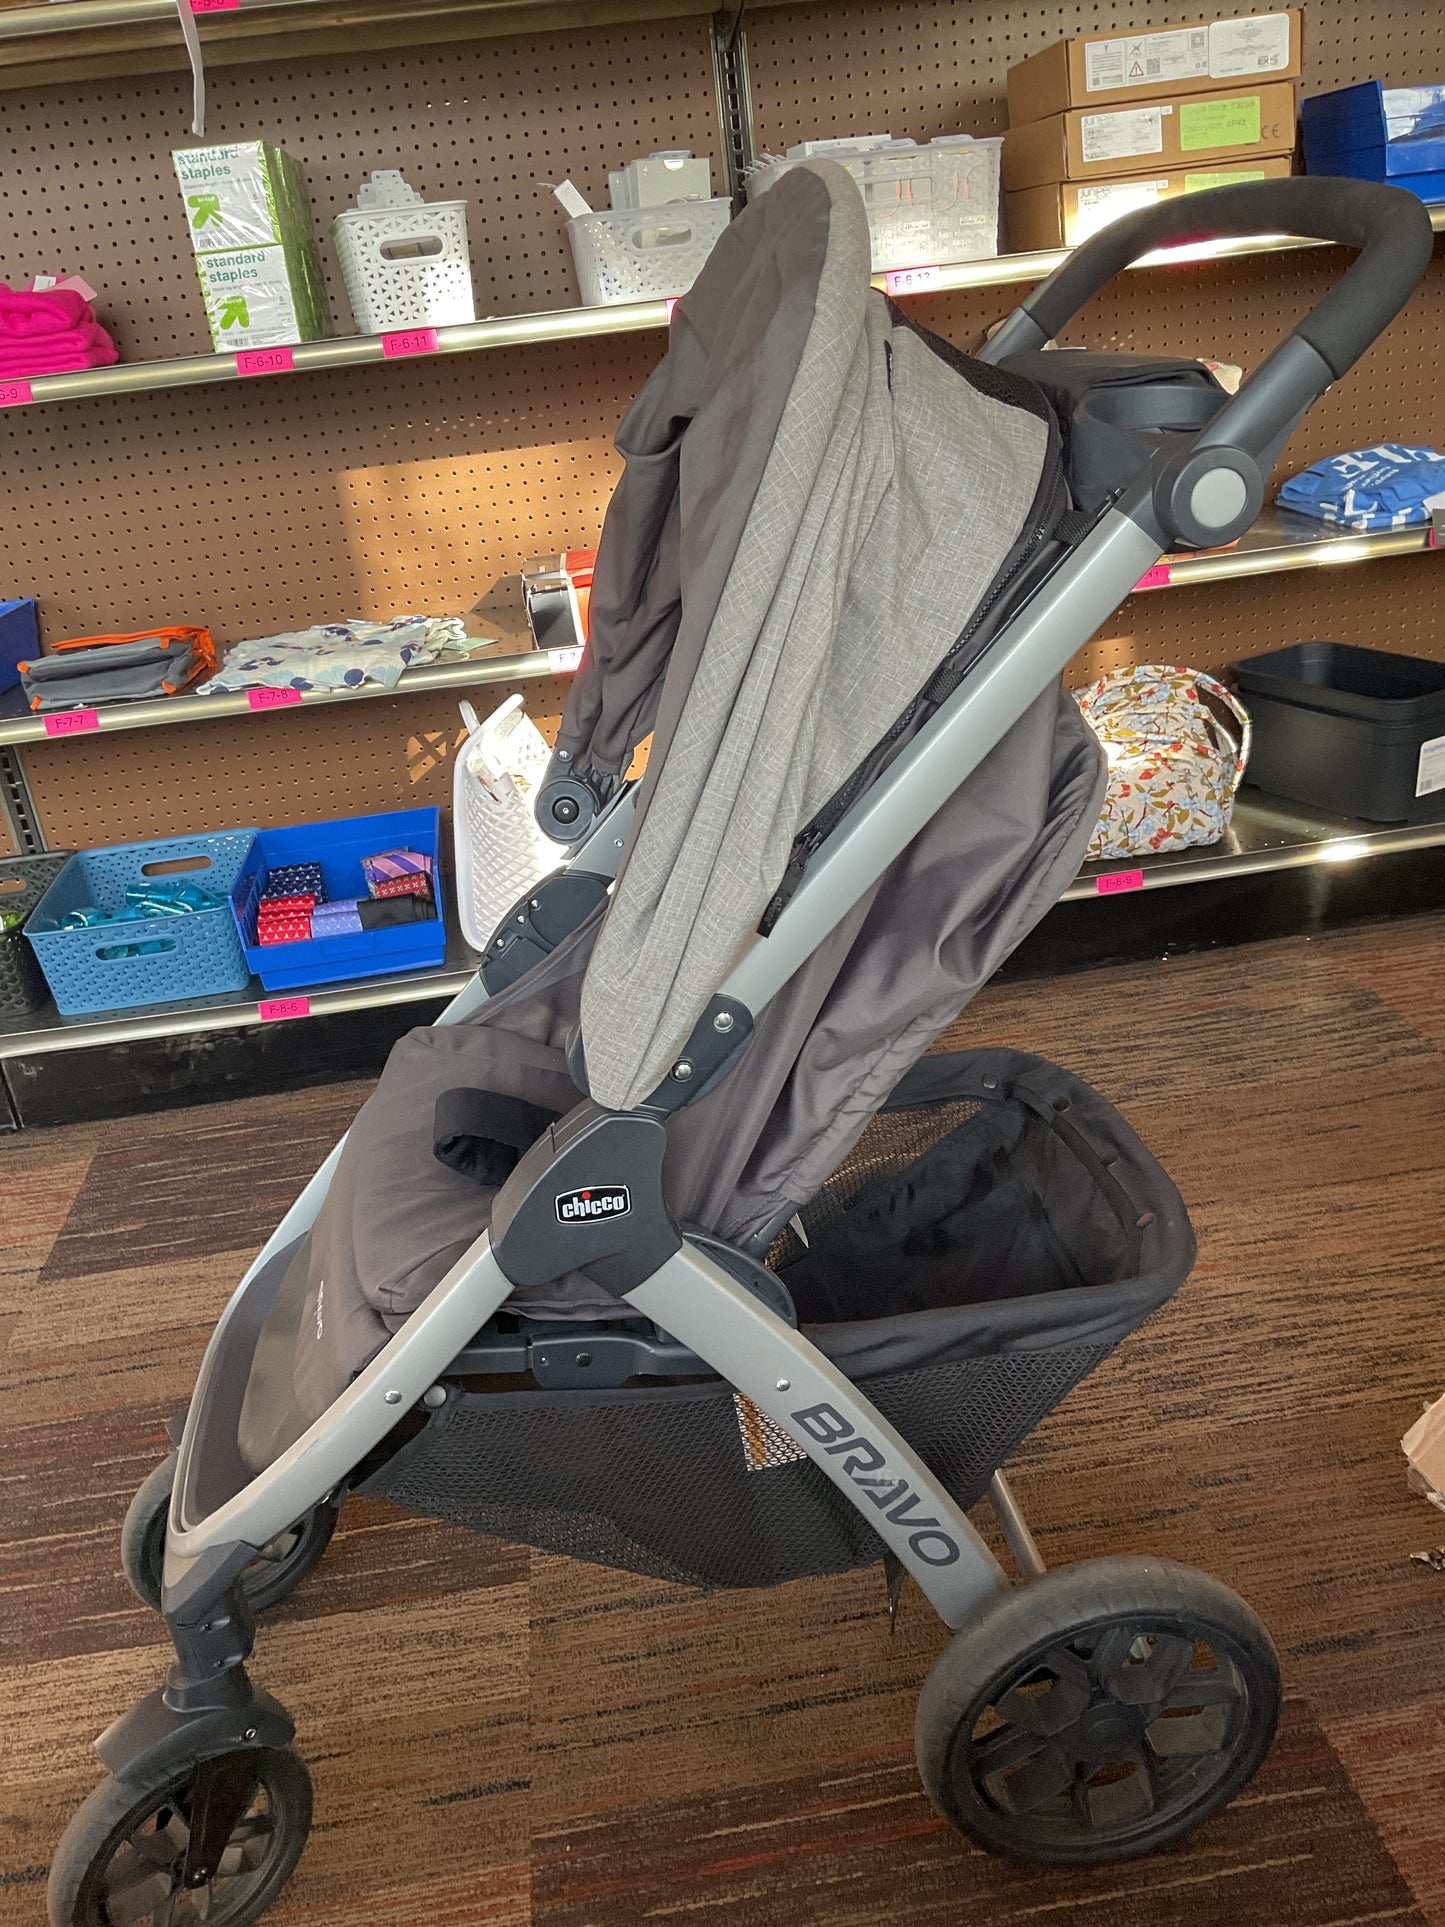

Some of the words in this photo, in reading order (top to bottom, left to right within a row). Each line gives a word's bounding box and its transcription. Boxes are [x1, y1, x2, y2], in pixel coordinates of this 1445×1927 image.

[181, 165, 231, 180] staples
[206, 251, 266, 269] standard
[209, 268, 258, 283] staples
[390, 335, 427, 350] F-6-11
[244, 354, 283, 369] F-6-10
[258, 690, 289, 703] F-7-8
[55, 716, 84, 729] F-7-7
[1106, 875, 1132, 888] F-8-9
[269, 1002, 298, 1015] F-8-6
[562, 1191, 625, 1218] chicco
[790, 1402, 961, 1567] BRAVO
